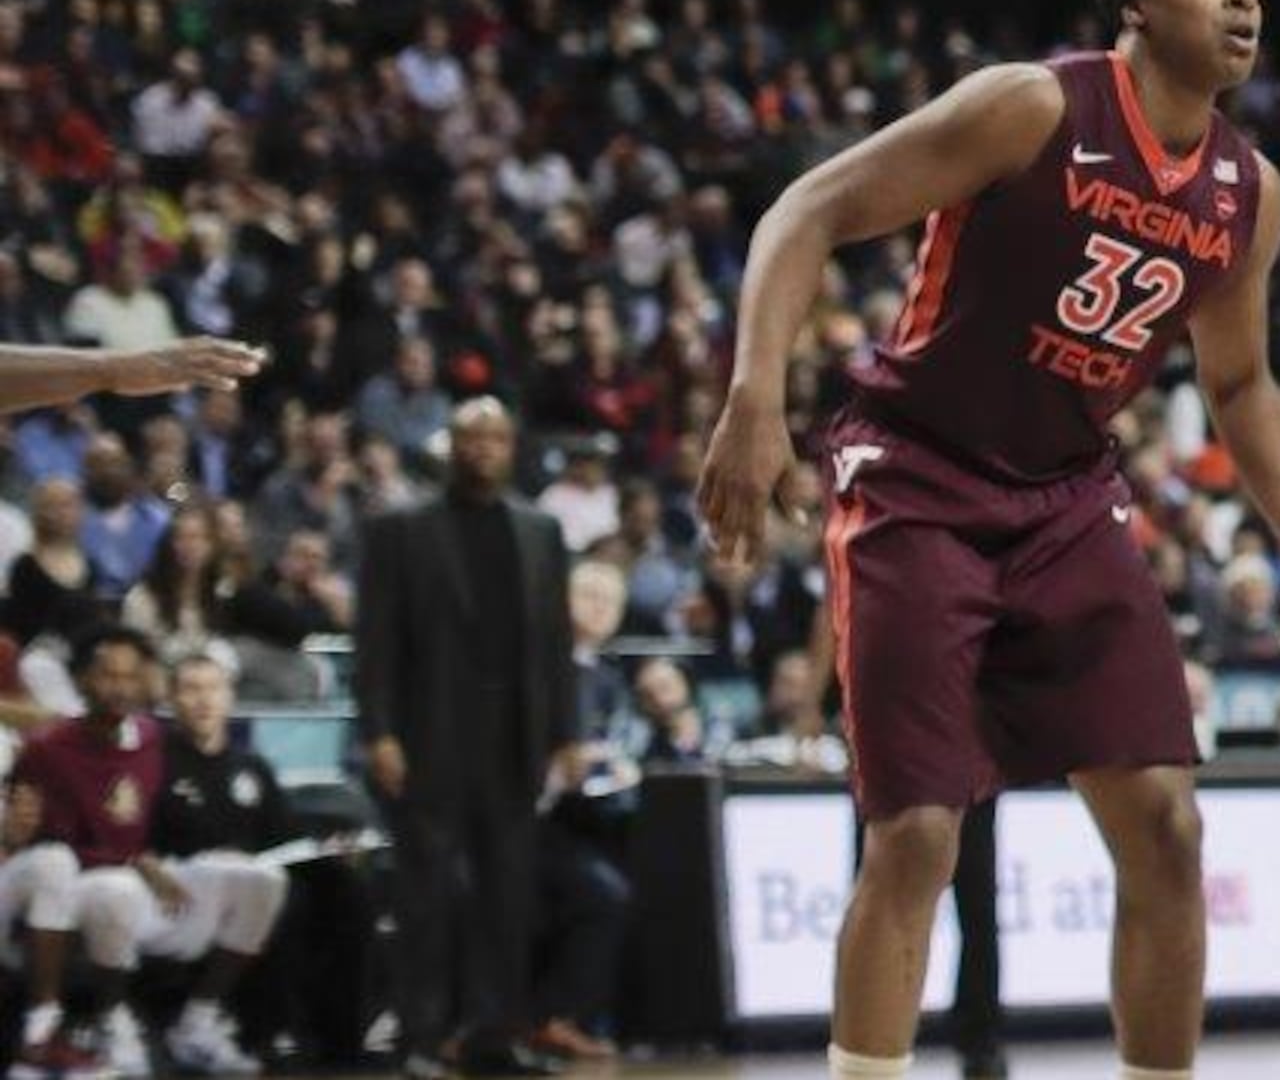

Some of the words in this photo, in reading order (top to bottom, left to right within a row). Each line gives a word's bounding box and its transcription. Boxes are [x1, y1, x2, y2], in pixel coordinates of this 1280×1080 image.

[1064, 167, 1232, 269] VIRGINIA
[1057, 231, 1185, 351] 32
[1026, 323, 1132, 387] TECH
